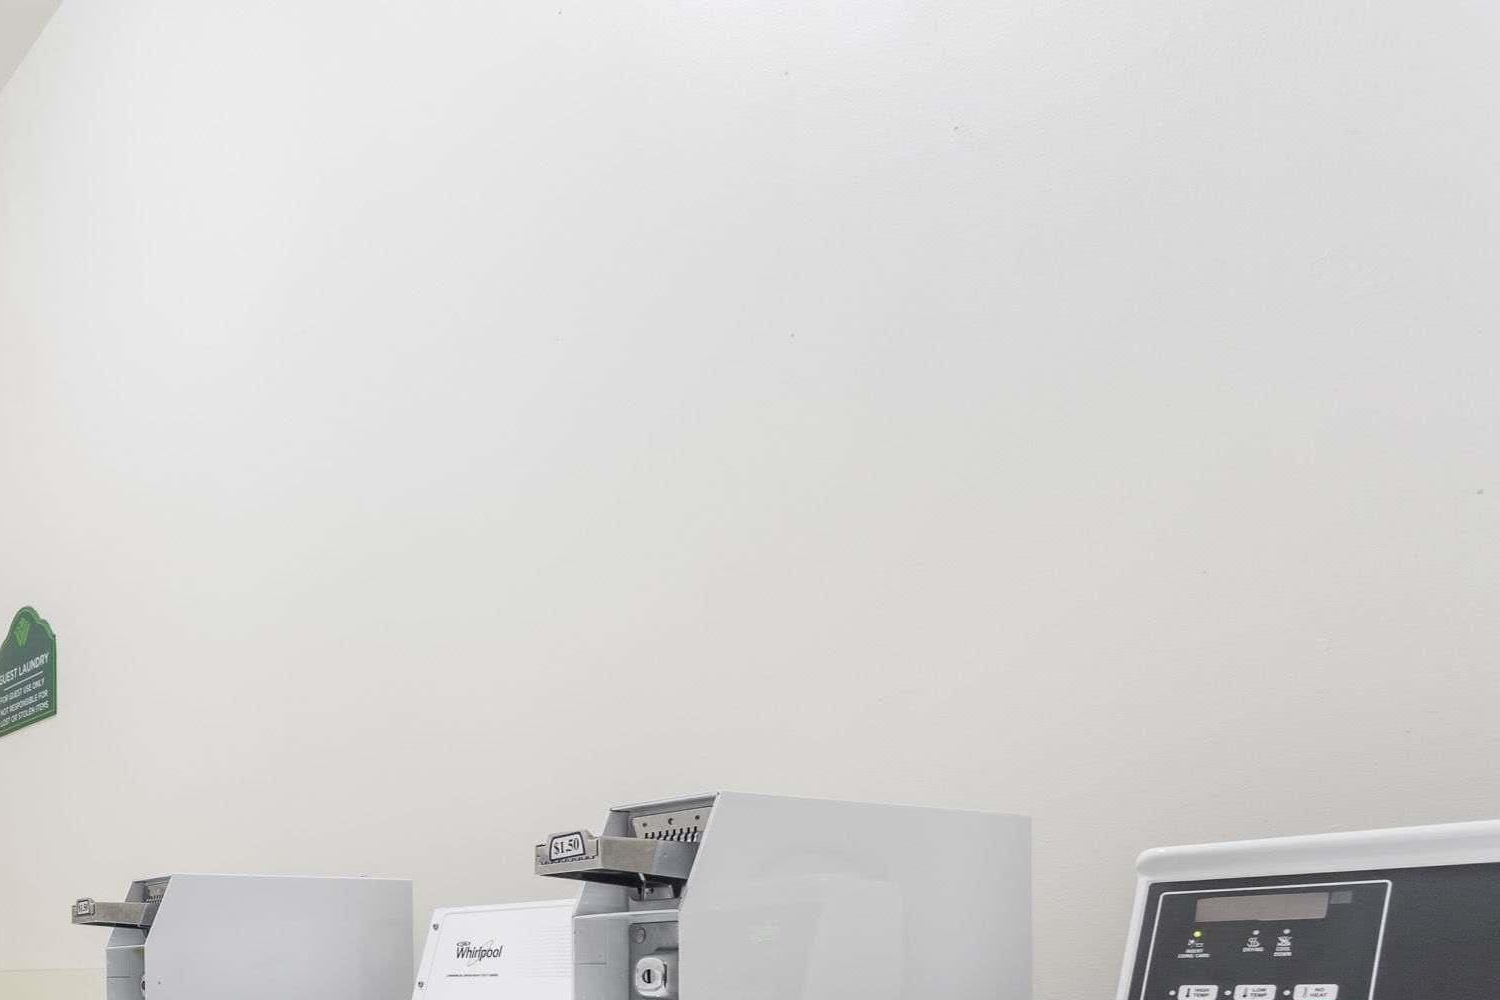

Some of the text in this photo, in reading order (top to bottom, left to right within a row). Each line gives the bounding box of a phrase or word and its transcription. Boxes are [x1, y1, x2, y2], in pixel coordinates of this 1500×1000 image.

[18, 652, 49, 675] LAUNDRY
[32, 677, 45, 689] ONLY
[553, 837, 580, 854] $1.50
[456, 944, 503, 961] Whirlpool
